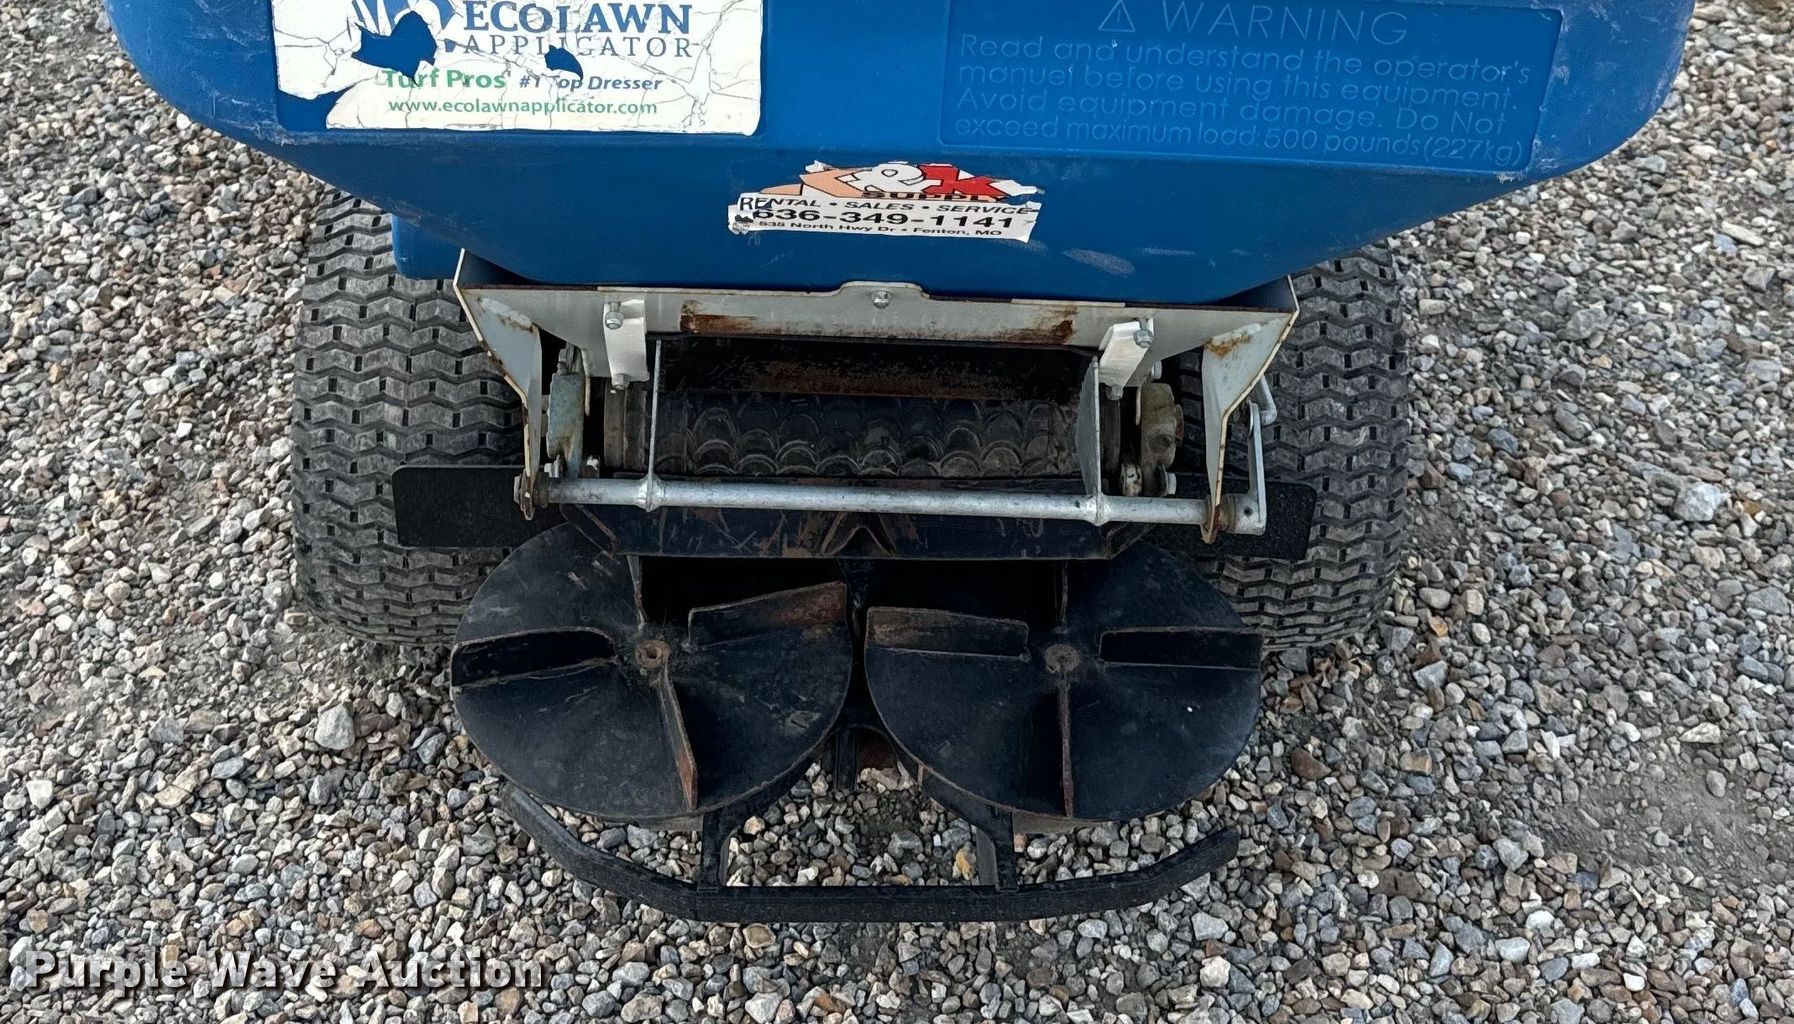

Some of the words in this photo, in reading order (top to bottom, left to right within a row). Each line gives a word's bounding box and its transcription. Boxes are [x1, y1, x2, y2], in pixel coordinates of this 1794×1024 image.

[462, 0, 693, 34] ECOLAWN
[1161, 0, 1409, 45] WARNING
[960, 34, 1044, 58] Read
[1054, 40, 1117, 61] and
[1126, 43, 1304, 72] understand
[1314, 49, 1363, 74] the
[1373, 59, 1531, 84] operator's
[588, 75, 663, 90] Dresser
[1084, 65, 1184, 91] before
[1195, 71, 1273, 101] using
[1283, 73, 1331, 99] this
[1341, 81, 1519, 110] equipment.
[388, 97, 658, 115] www.ecolawnapplicator.com
[956, 87, 1047, 112] Avoid
[1058, 95, 1229, 120] equipment
[1239, 100, 1384, 131] damage.
[1396, 108, 1439, 131] Do
[1450, 111, 1507, 135] Not
[954, 116, 1059, 138] exceed
[1065, 118, 1193, 143] maximum
[1263, 128, 1318, 151] 500
[739, 197, 821, 211] RENTAL
[844, 201, 915, 211] SALES
[936, 204, 1031, 215] SERVICE
[753, 208, 1013, 228] 636-349-1141
[790, 222, 834, 230] North
[838, 224, 873, 232] Hwy
